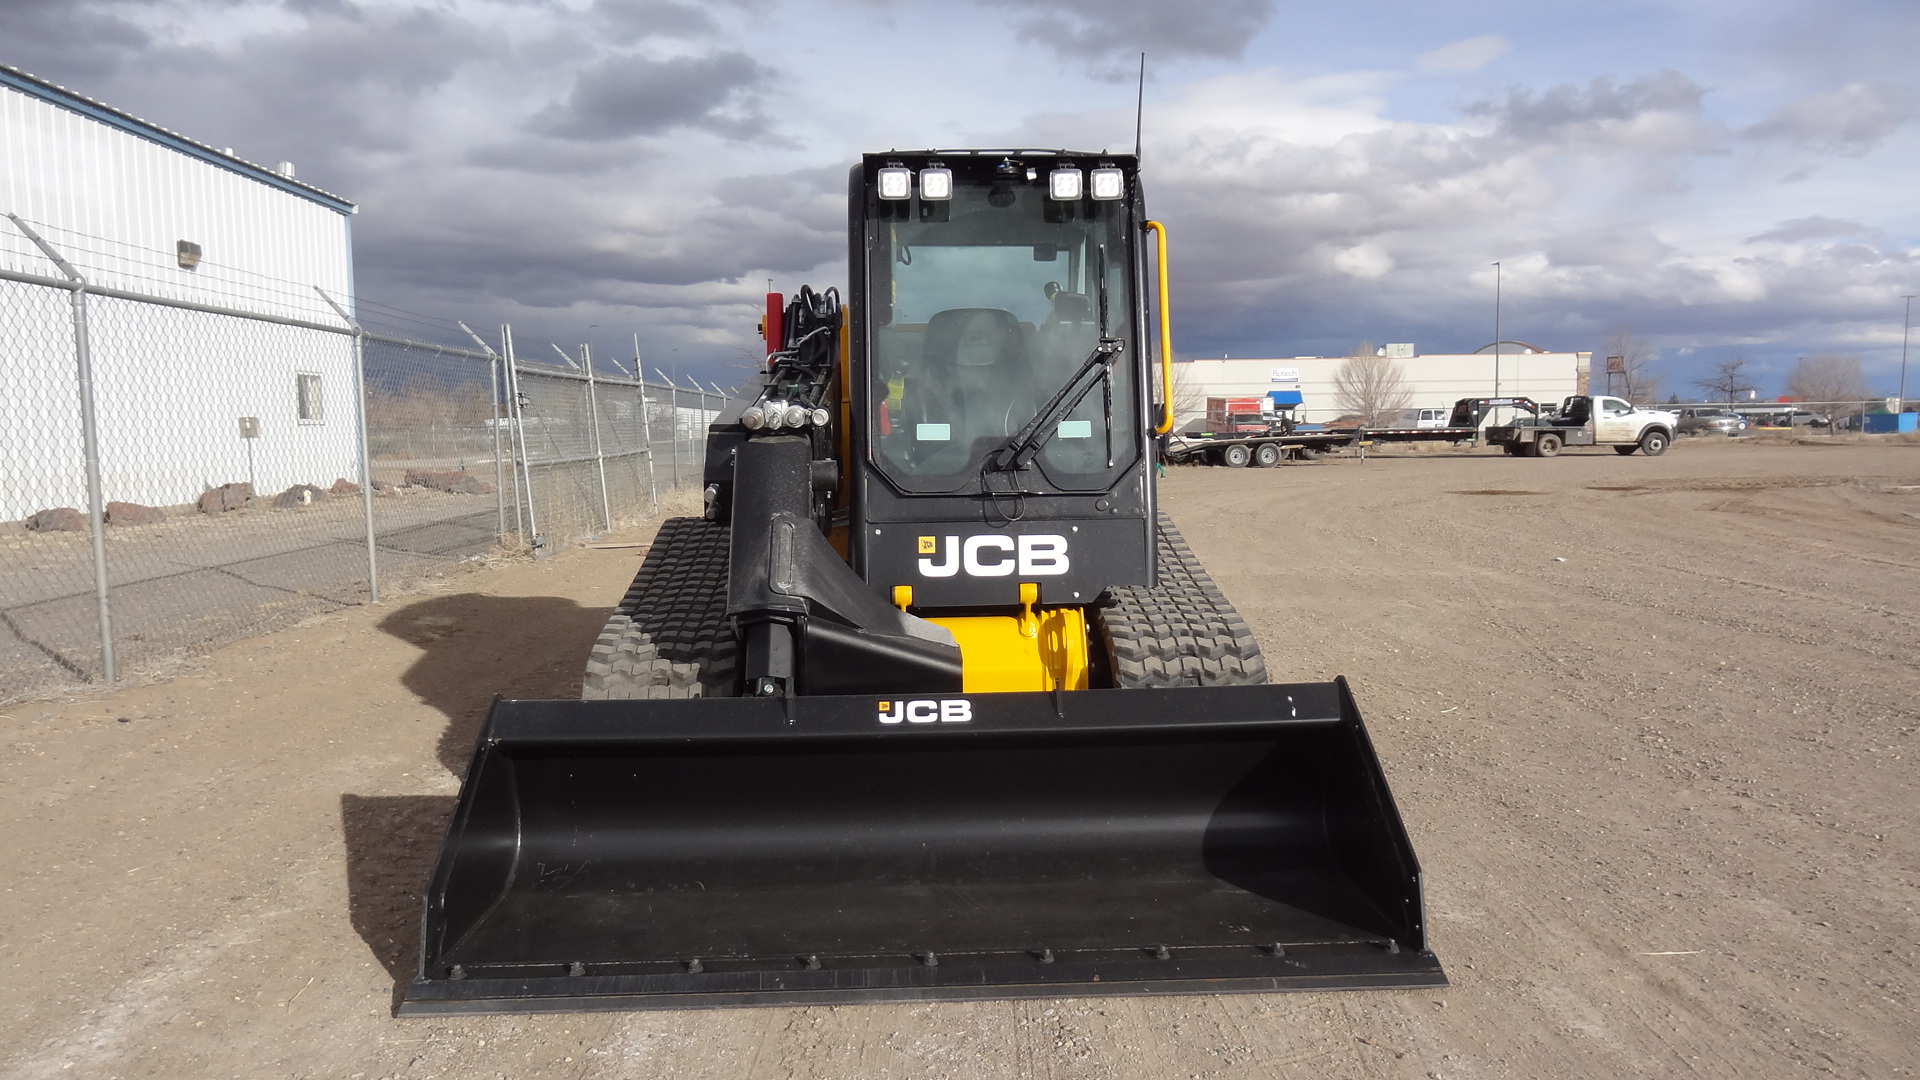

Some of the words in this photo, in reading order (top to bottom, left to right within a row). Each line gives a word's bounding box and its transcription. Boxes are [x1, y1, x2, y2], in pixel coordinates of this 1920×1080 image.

[1272, 369, 1298, 377] Rotech
[918, 535, 1069, 577] JCB
[878, 699, 972, 724] JCB
